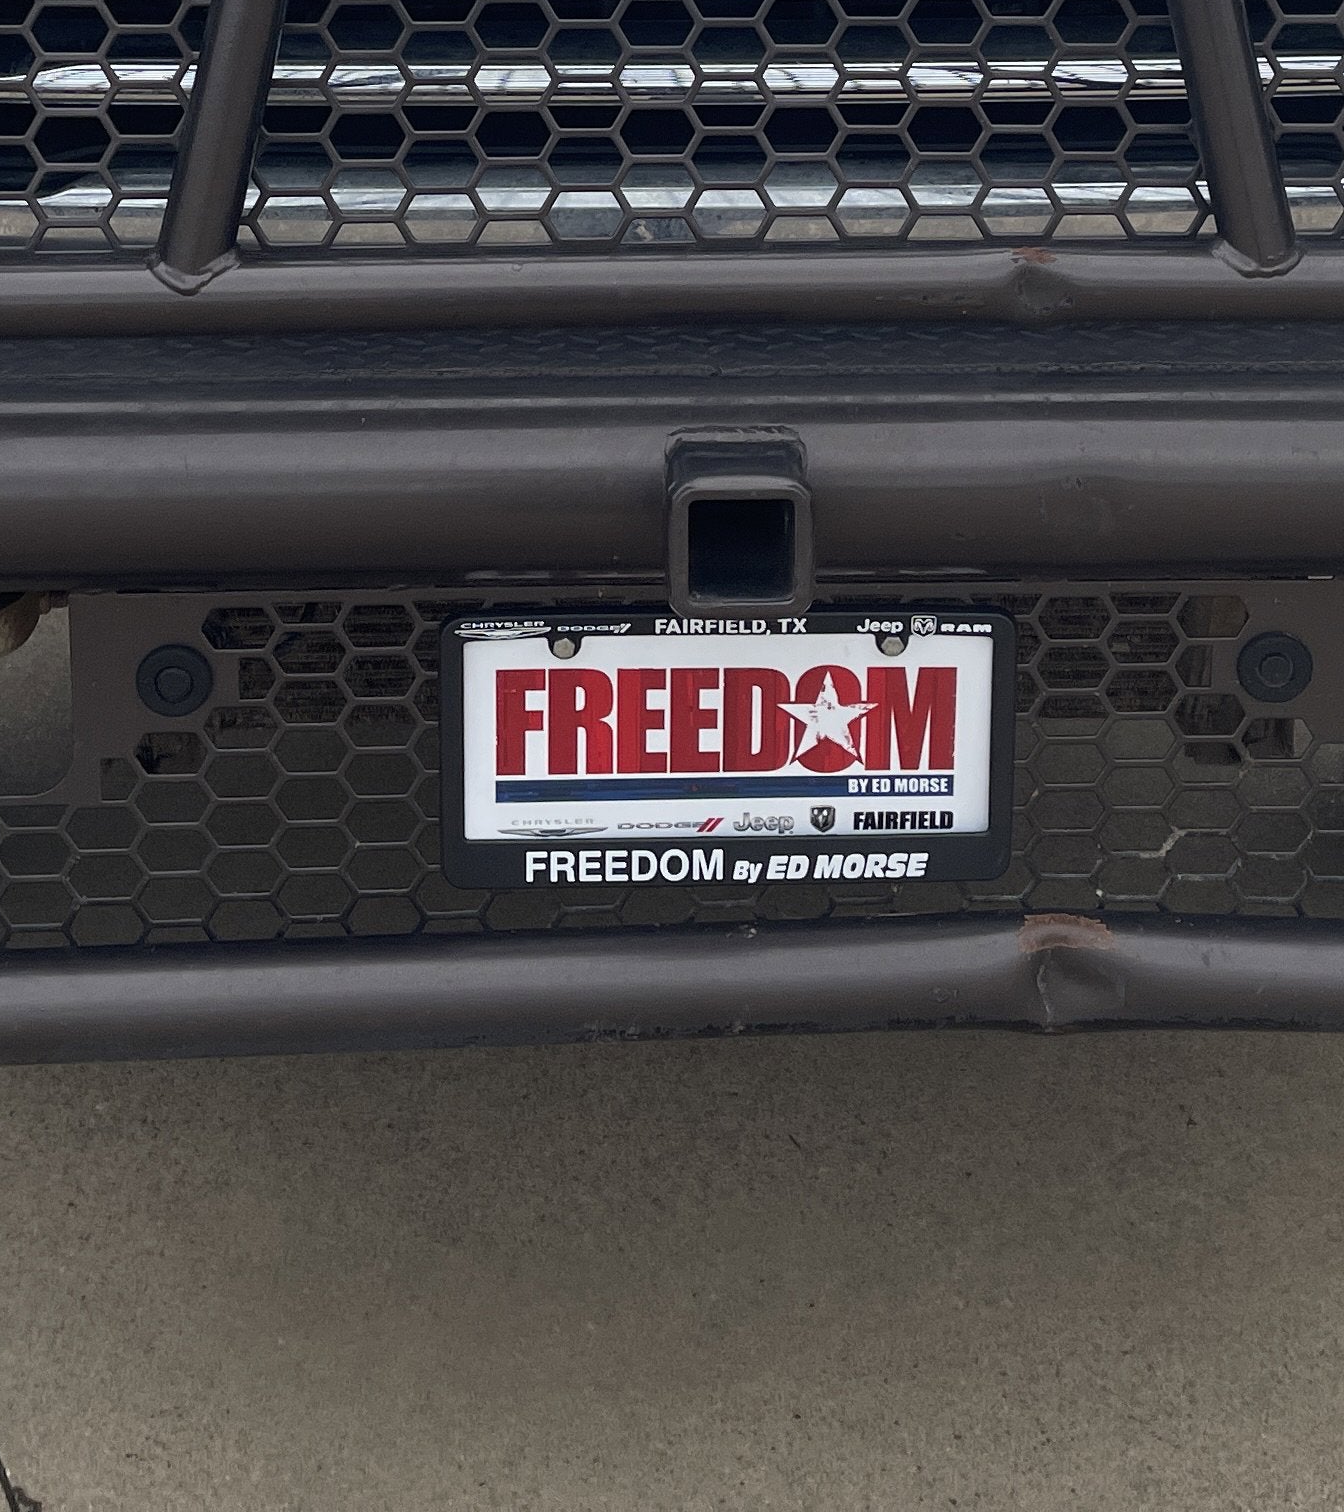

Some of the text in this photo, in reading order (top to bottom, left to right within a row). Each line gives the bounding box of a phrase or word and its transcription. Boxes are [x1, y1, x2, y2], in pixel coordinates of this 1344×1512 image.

[460, 620, 545, 630] CHRYSLER
[654, 618, 807, 636] FAIRFIELD, TX
[856, 618, 904, 633] Jeep
[940, 623, 993, 633] RAM
[495, 664, 958, 776] FREEDOM
[848, 777, 949, 793] BY ED MORSE
[511, 818, 594, 826] CHRYSLER
[733, 812, 793, 834] Jeep
[853, 810, 954, 830] FAIRFIELD
[525, 848, 929, 884] FREEDOM By ED MORSE
